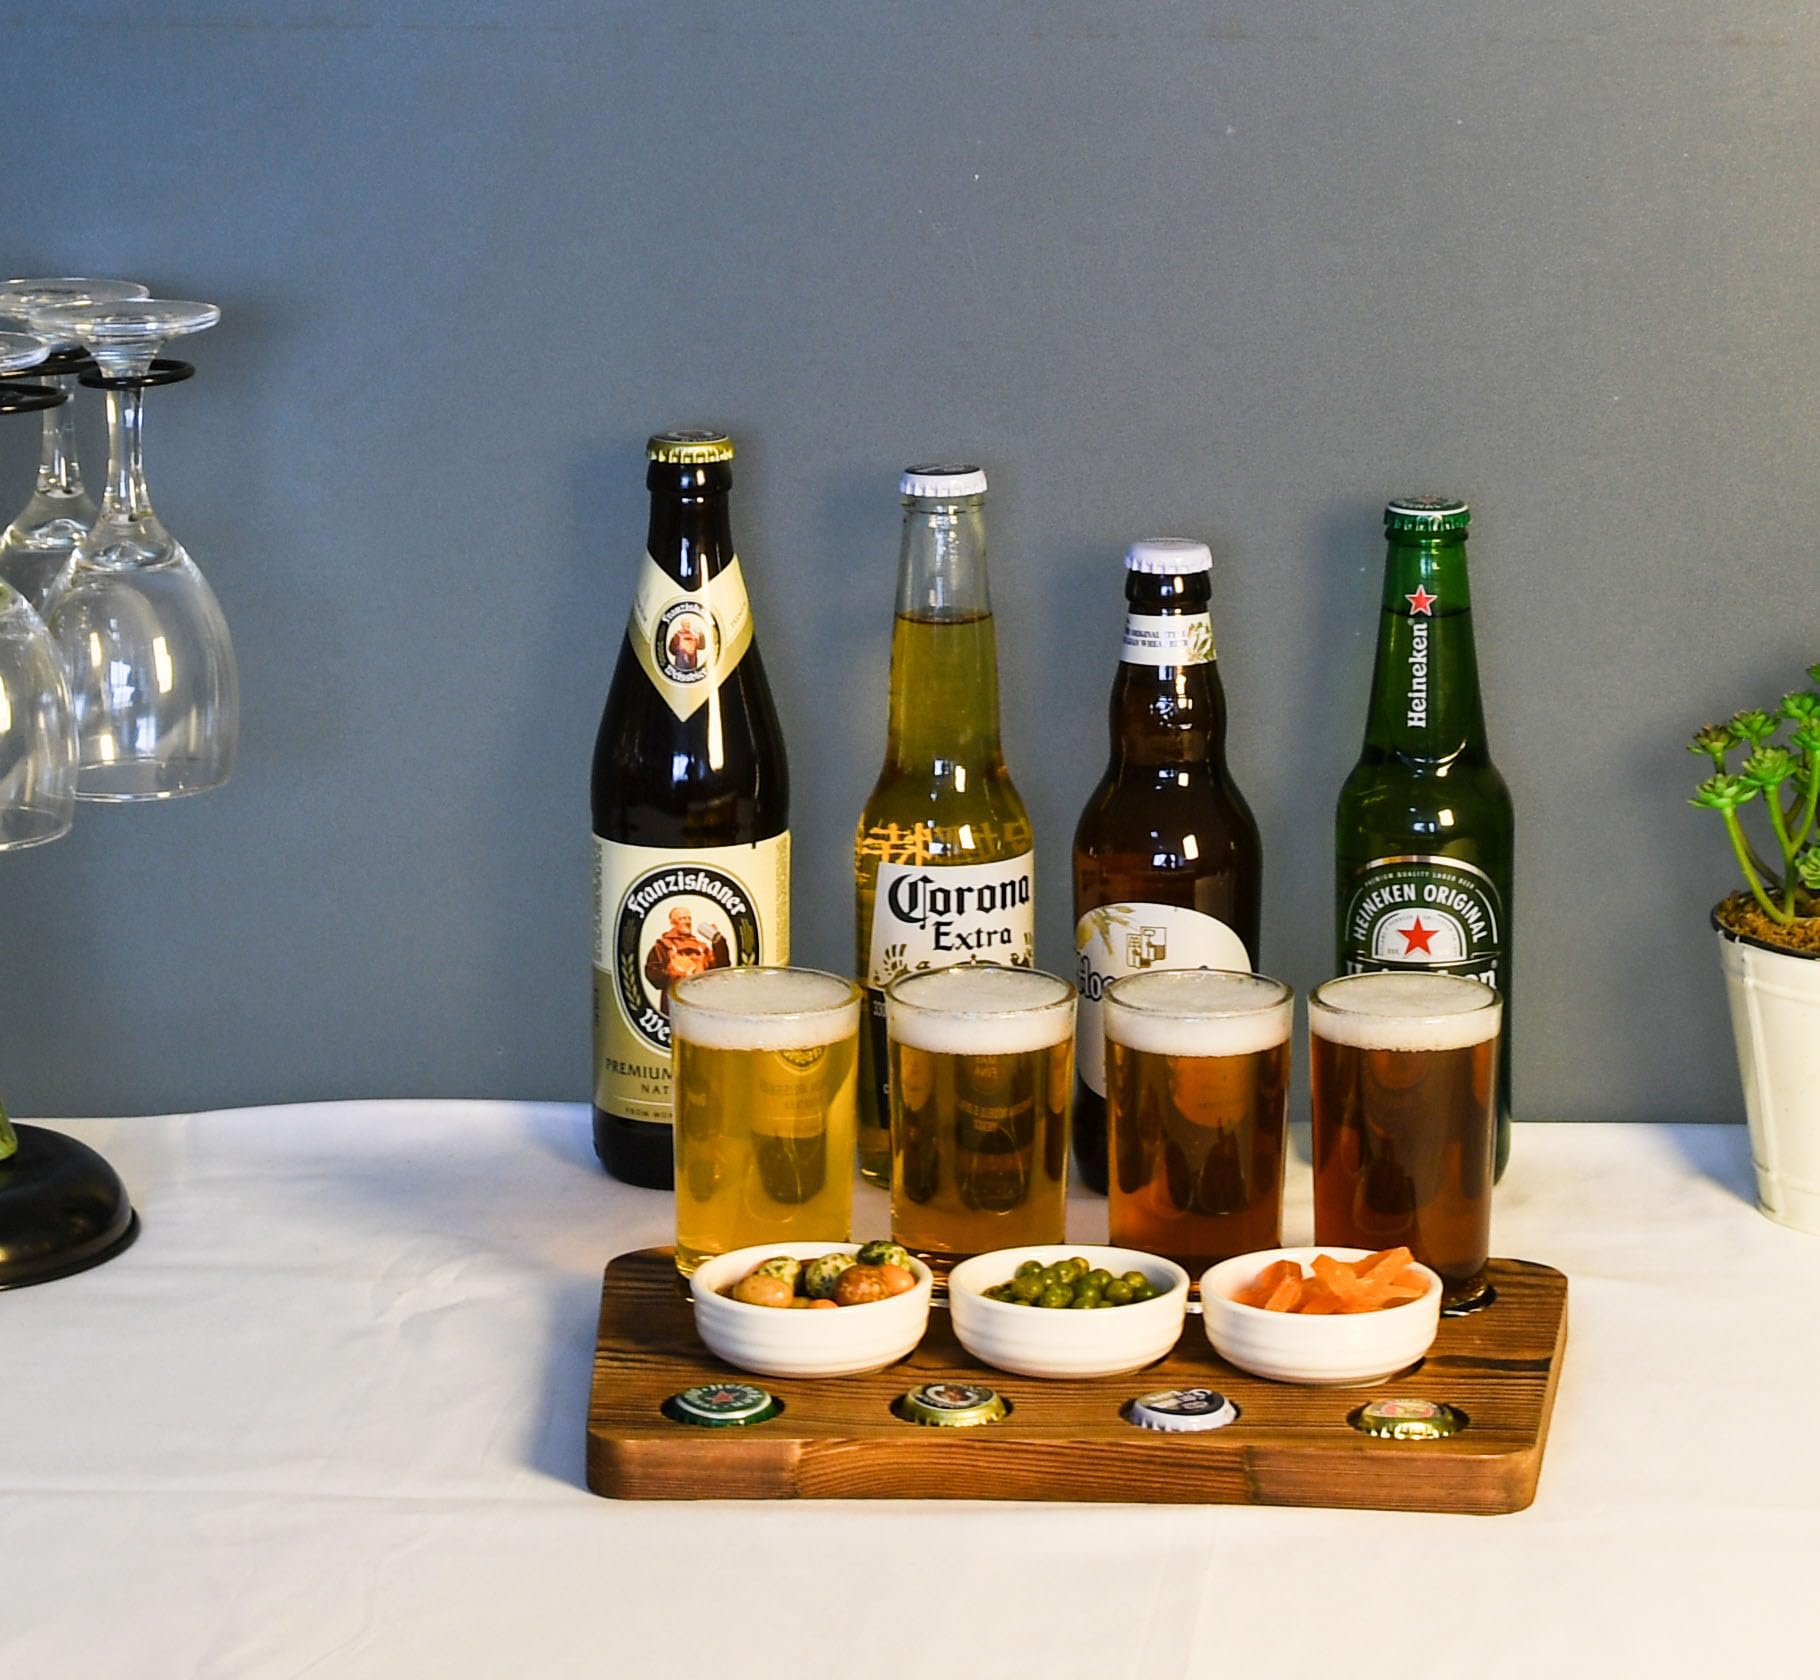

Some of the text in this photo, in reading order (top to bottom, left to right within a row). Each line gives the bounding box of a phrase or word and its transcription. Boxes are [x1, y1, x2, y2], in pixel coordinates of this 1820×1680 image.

[1407, 622, 1428, 729] Heineken
[627, 870, 747, 919] Franziskaner
[888, 874, 1031, 930] Corona
[1353, 883, 1416, 941] HEINEKEN
[1423, 884, 1488, 944] ORIGINAL
[933, 921, 1012, 951] Extra
